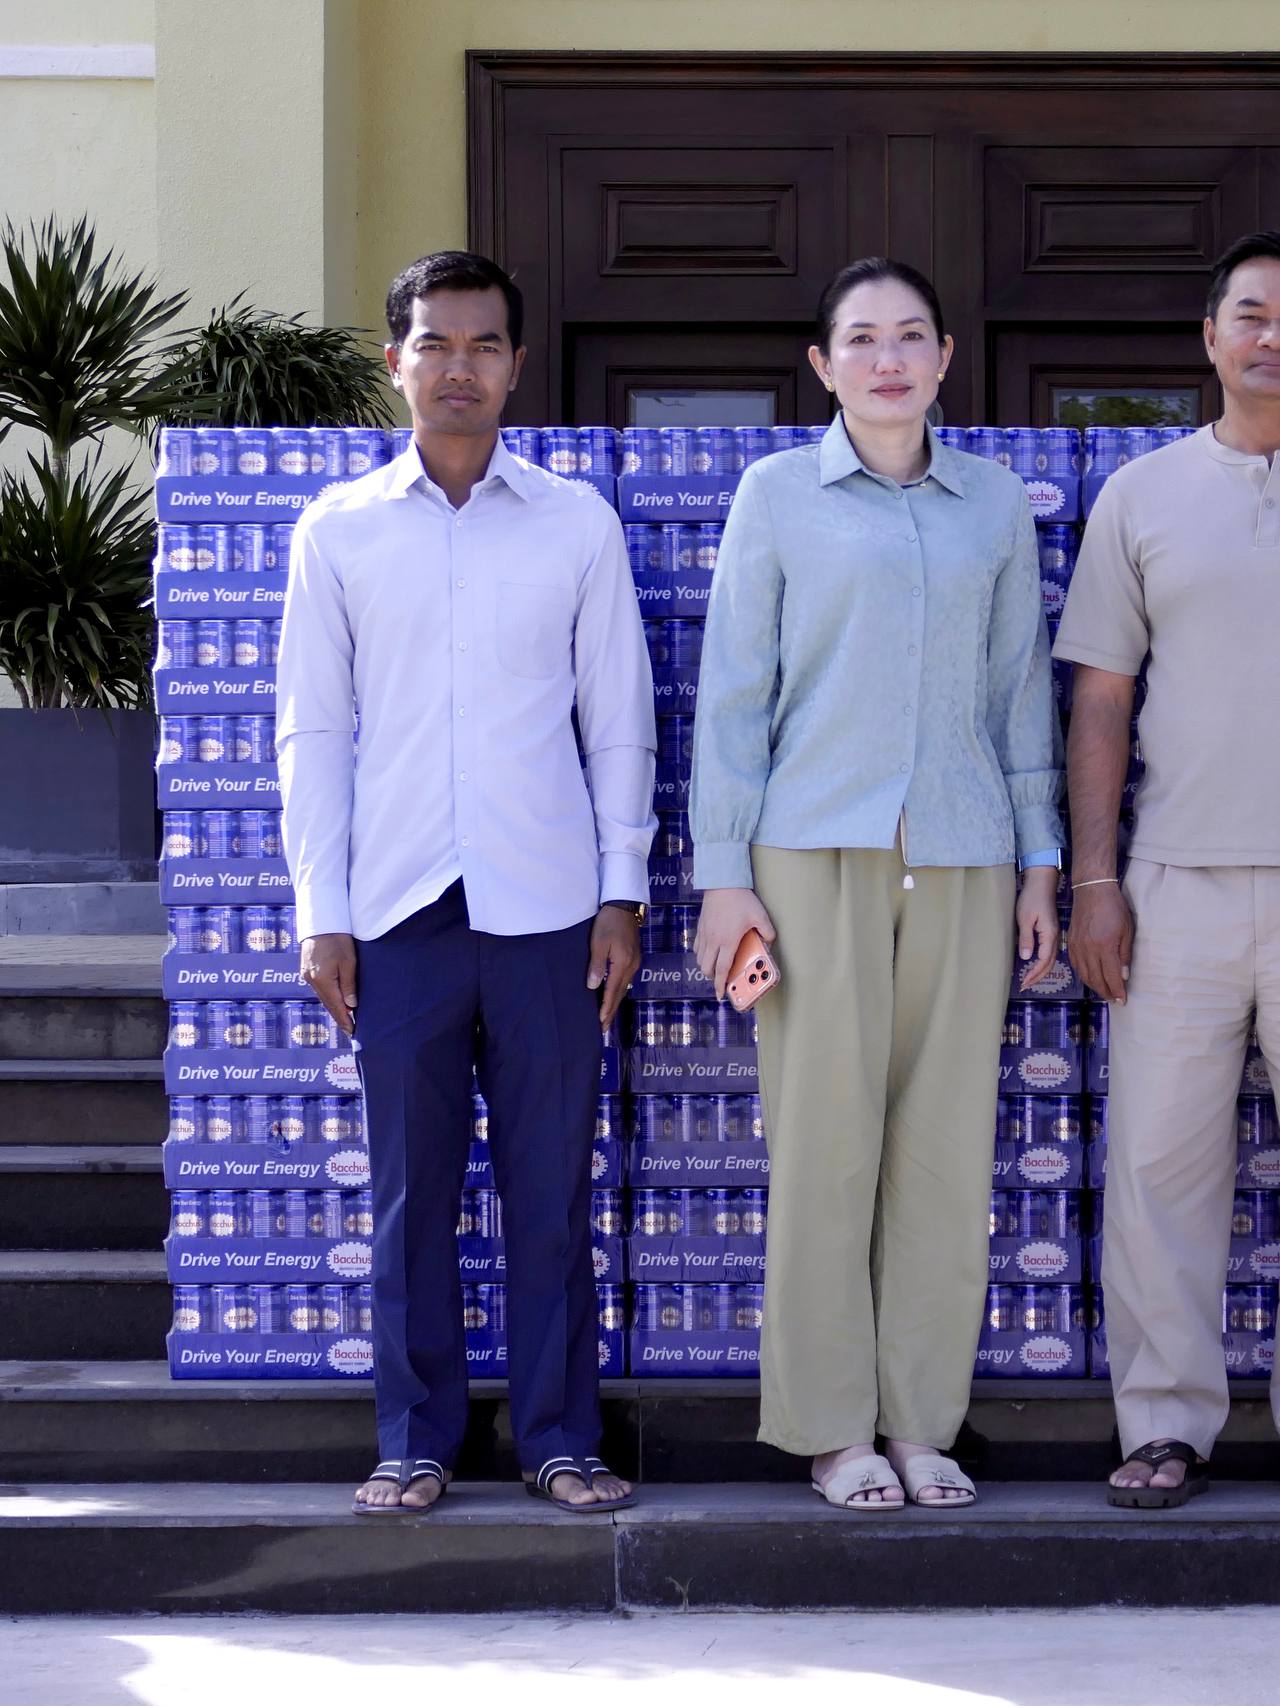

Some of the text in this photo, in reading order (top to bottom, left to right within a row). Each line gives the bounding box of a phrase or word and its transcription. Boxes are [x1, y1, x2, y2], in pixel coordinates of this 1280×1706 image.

[170, 491, 311, 509] Drive Your Energy
[633, 493, 673, 506] Drive
[678, 492, 714, 505] Your
[168, 588, 250, 602] Drive Your
[168, 682, 209, 694] Drive
[213, 681, 250, 694] Your
[170, 778, 251, 792] Drive Your
[174, 873, 254, 887] Drive Your
[649, 873, 677, 886] rive
[178, 970, 306, 986] Drive Your Energ
[641, 968, 681, 982] Drive
[179, 1066, 320, 1082] Drive Your Energy
[643, 1063, 757, 1076] Drive Your Ene
[1026, 1064, 1065, 1075] Bacchus
[642, 1156, 769, 1173] Drive Your Energ
[1024, 1156, 1063, 1167] Bacchus
[180, 1161, 320, 1177] Drive Your Energy
[180, 1252, 321, 1269] Drive Your Energy
[638, 1252, 767, 1269] Drive Your Energ
[1024, 1254, 1062, 1265] Bacchus
[181, 1350, 322, 1366] Drive Your Energy
[466, 1348, 492, 1360] our
[643, 1347, 724, 1360] Drive Your
[978, 1350, 1013, 1363] ergy
[1027, 1348, 1066, 1359] Bacchus
